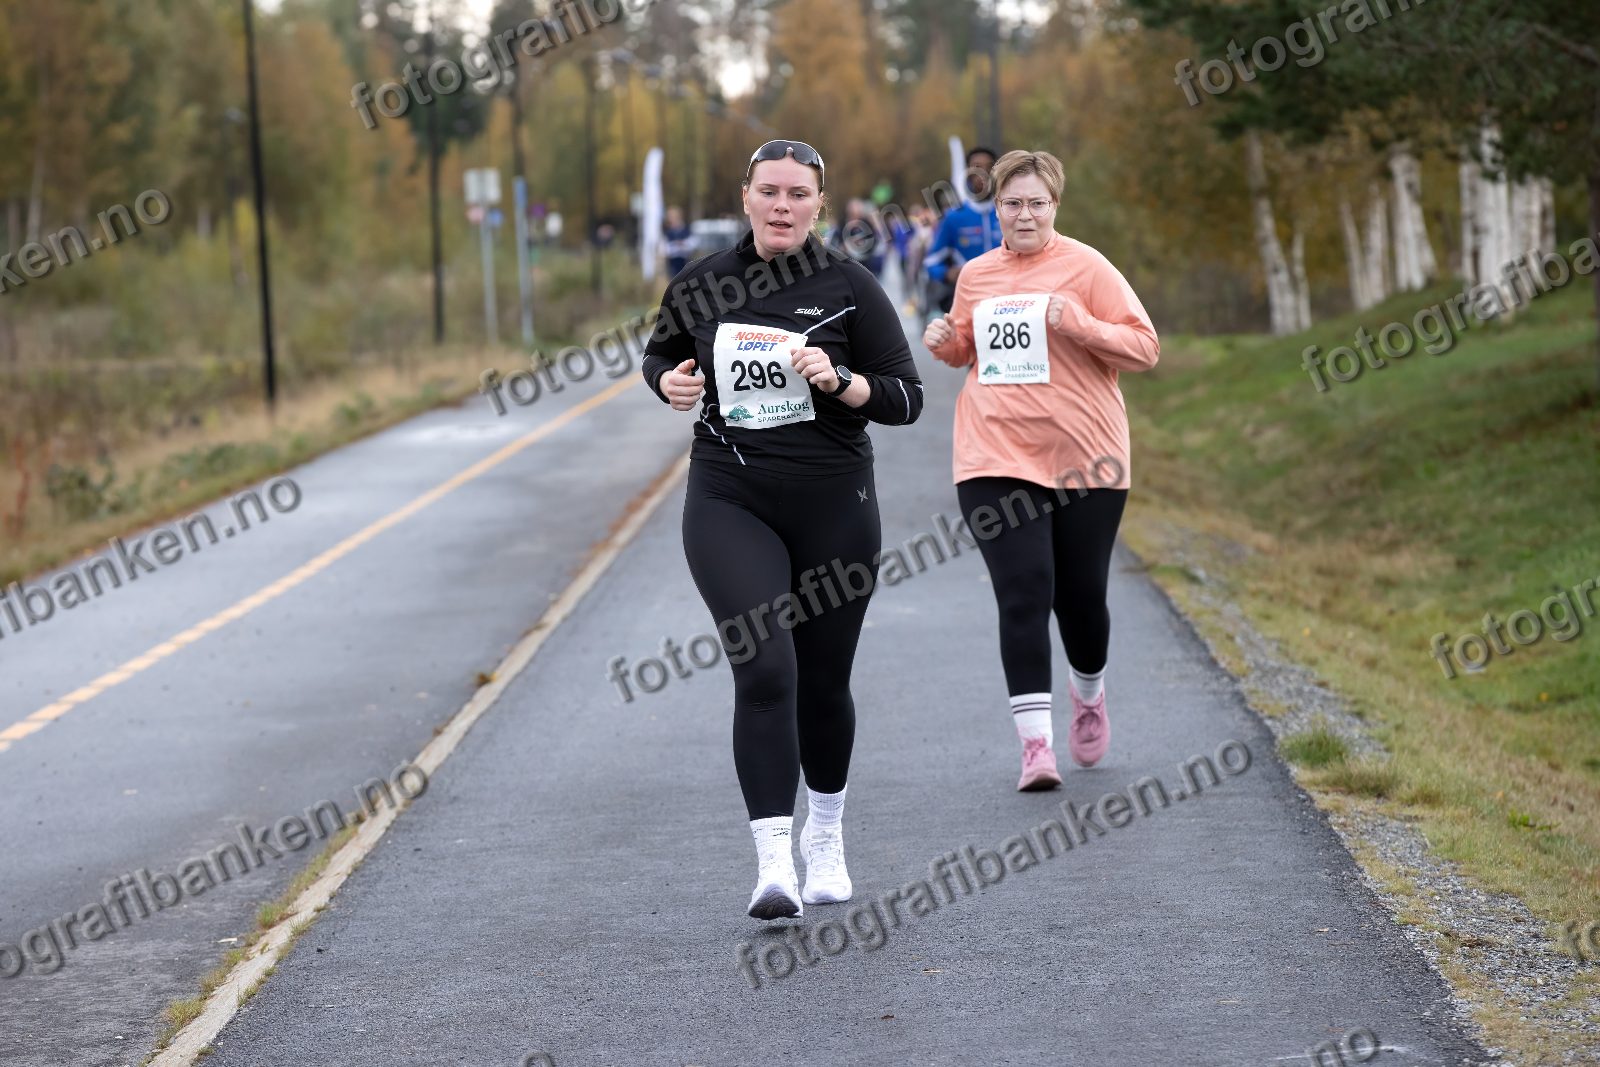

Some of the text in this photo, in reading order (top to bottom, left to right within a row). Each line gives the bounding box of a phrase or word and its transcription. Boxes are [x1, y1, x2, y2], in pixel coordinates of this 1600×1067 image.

[735, 331, 790, 343] NORGES
[988, 322, 1031, 350] 286
[737, 341, 778, 352] LØPET
[1005, 362, 1046, 373] Aurskog
[731, 360, 787, 391] 296
[758, 400, 810, 415] Aurskog
